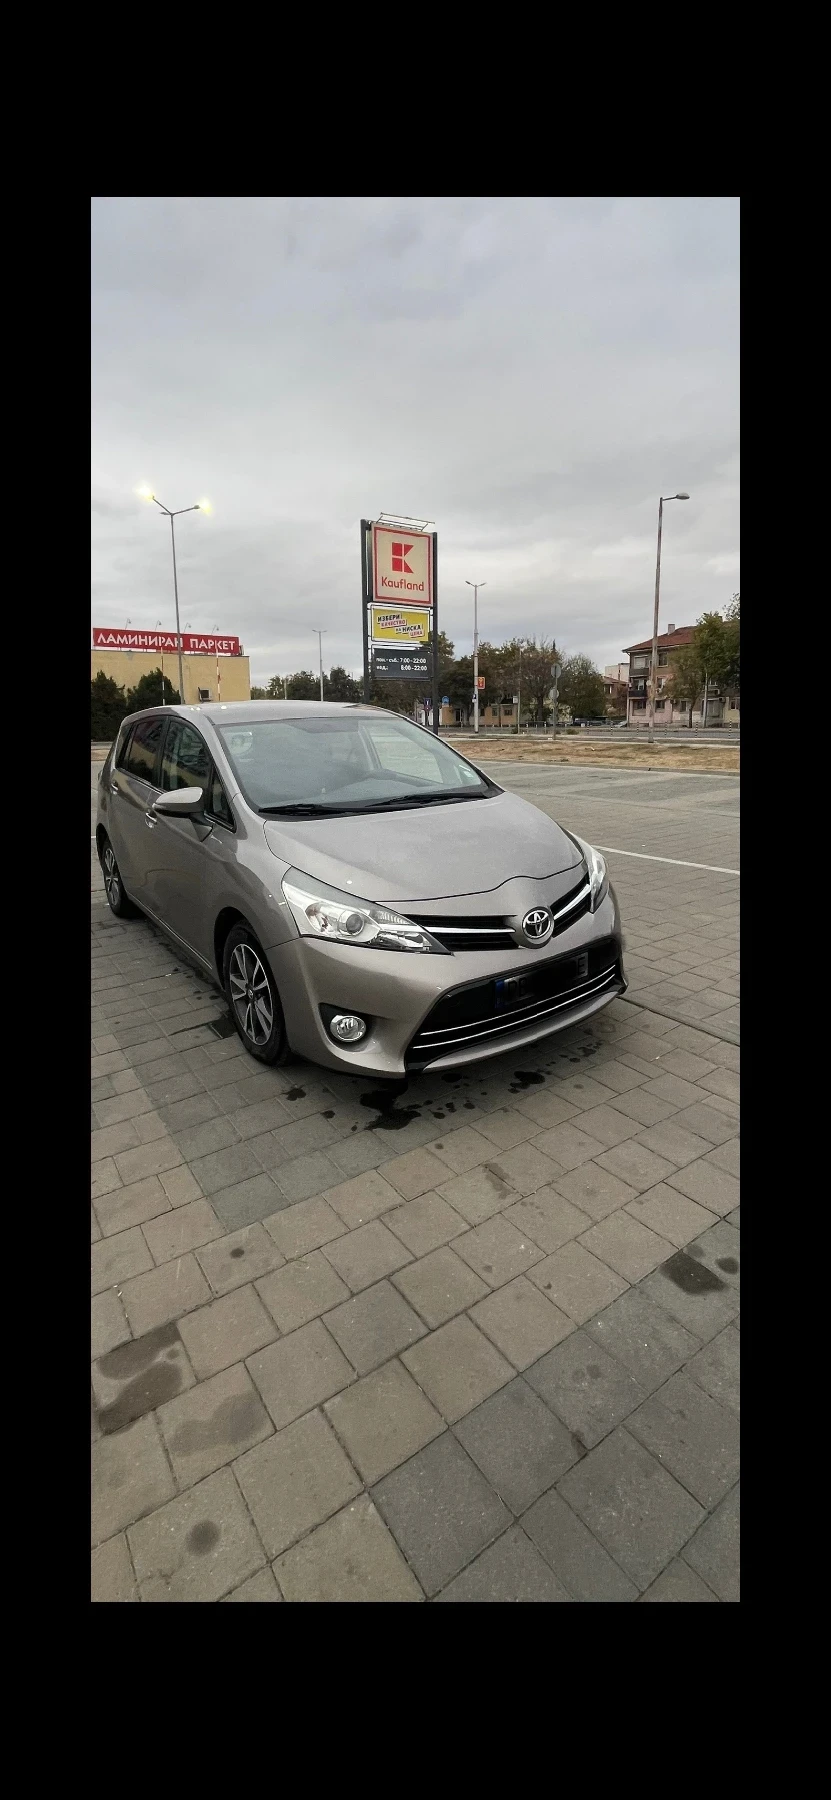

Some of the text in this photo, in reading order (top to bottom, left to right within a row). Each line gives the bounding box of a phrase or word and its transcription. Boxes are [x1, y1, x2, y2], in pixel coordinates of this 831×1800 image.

[381, 576, 425, 592] Kaufland
[377, 614, 400, 622] ИЗБЕРИ
[381, 619, 406, 627] КАЧЕСТВО
[402, 624, 421, 632] НИСКА
[97, 632, 236, 651] ЛАМИНИРАН ПАРКЕТ
